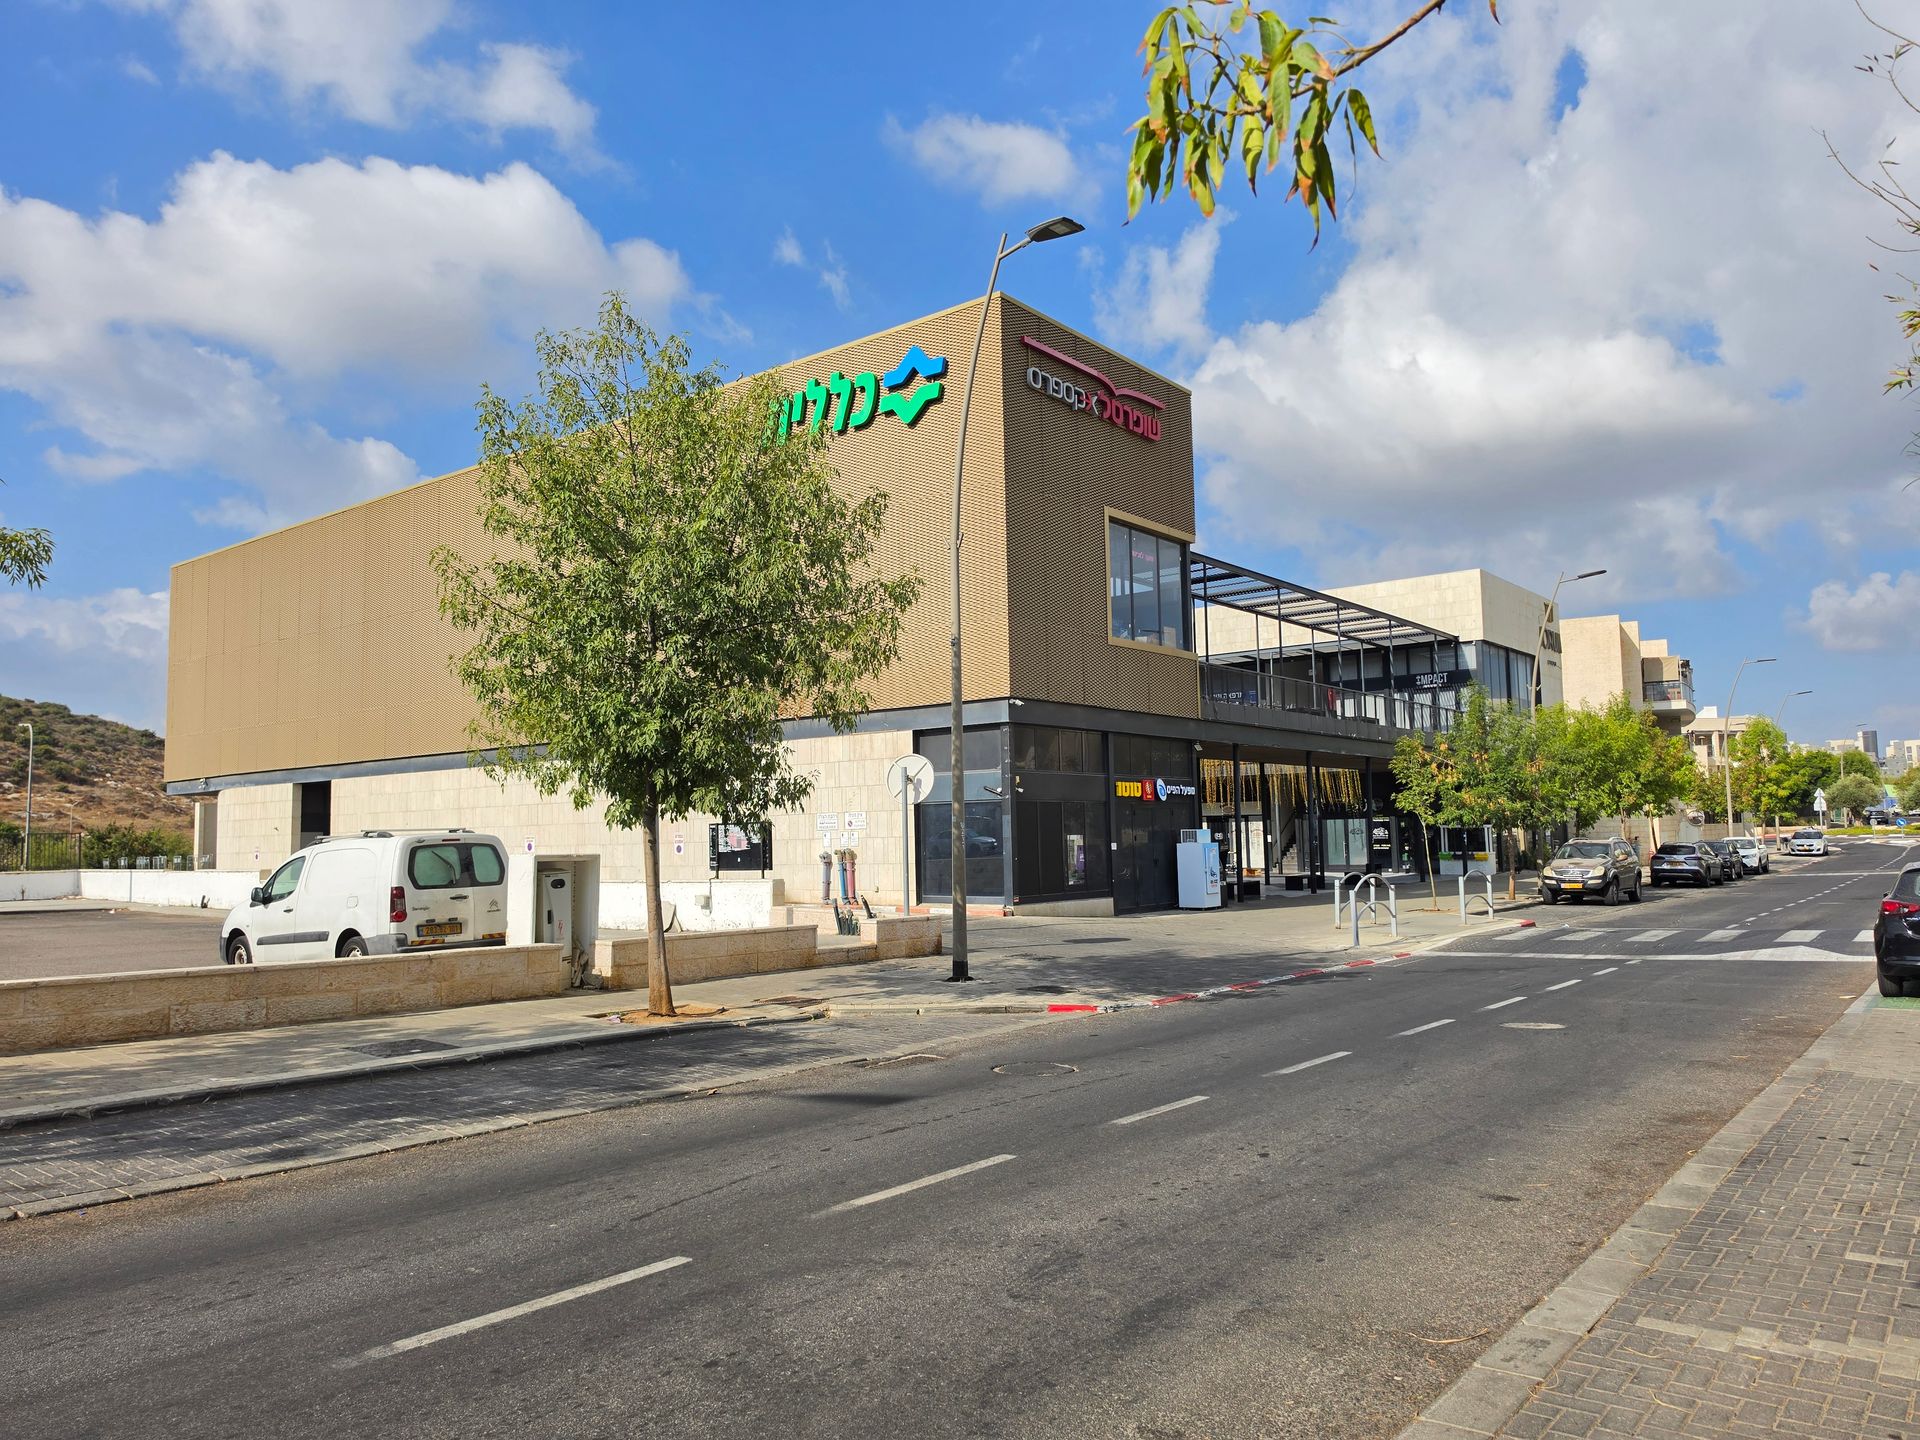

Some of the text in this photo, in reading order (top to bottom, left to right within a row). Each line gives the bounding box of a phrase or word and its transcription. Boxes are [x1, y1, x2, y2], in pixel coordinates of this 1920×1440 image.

[1098, 390, 1161, 441] שופרסל
[1416, 672, 1448, 685] IMPACT
[1167, 785, 1195, 795] מפעל הפיס
